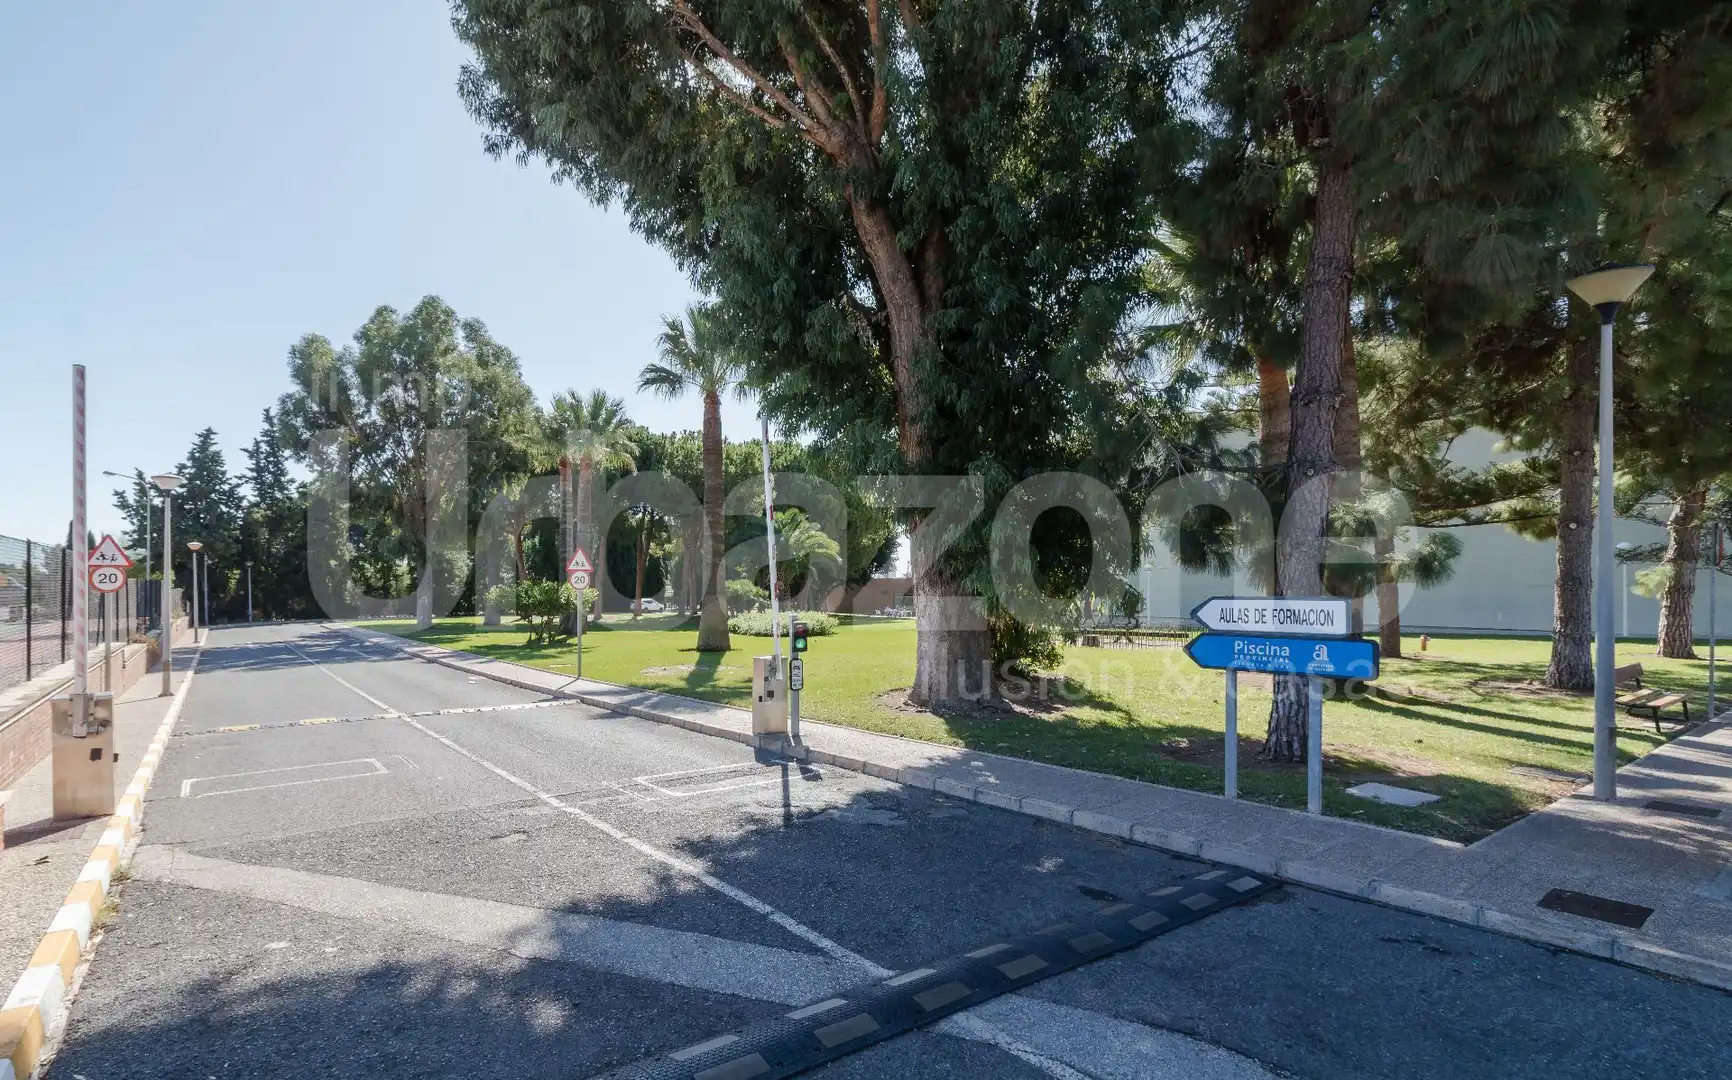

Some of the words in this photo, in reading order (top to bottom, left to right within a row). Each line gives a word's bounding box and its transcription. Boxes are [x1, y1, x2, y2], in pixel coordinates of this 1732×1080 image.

[98, 573, 118, 584] 20
[574, 575, 586, 584] 20
[1219, 607, 1250, 625] AULAS
[1254, 608, 1267, 625] DE
[1272, 608, 1335, 627] FORMACION
[1234, 640, 1290, 657] Piscina
[1234, 654, 1290, 664] PROVINCIAL
